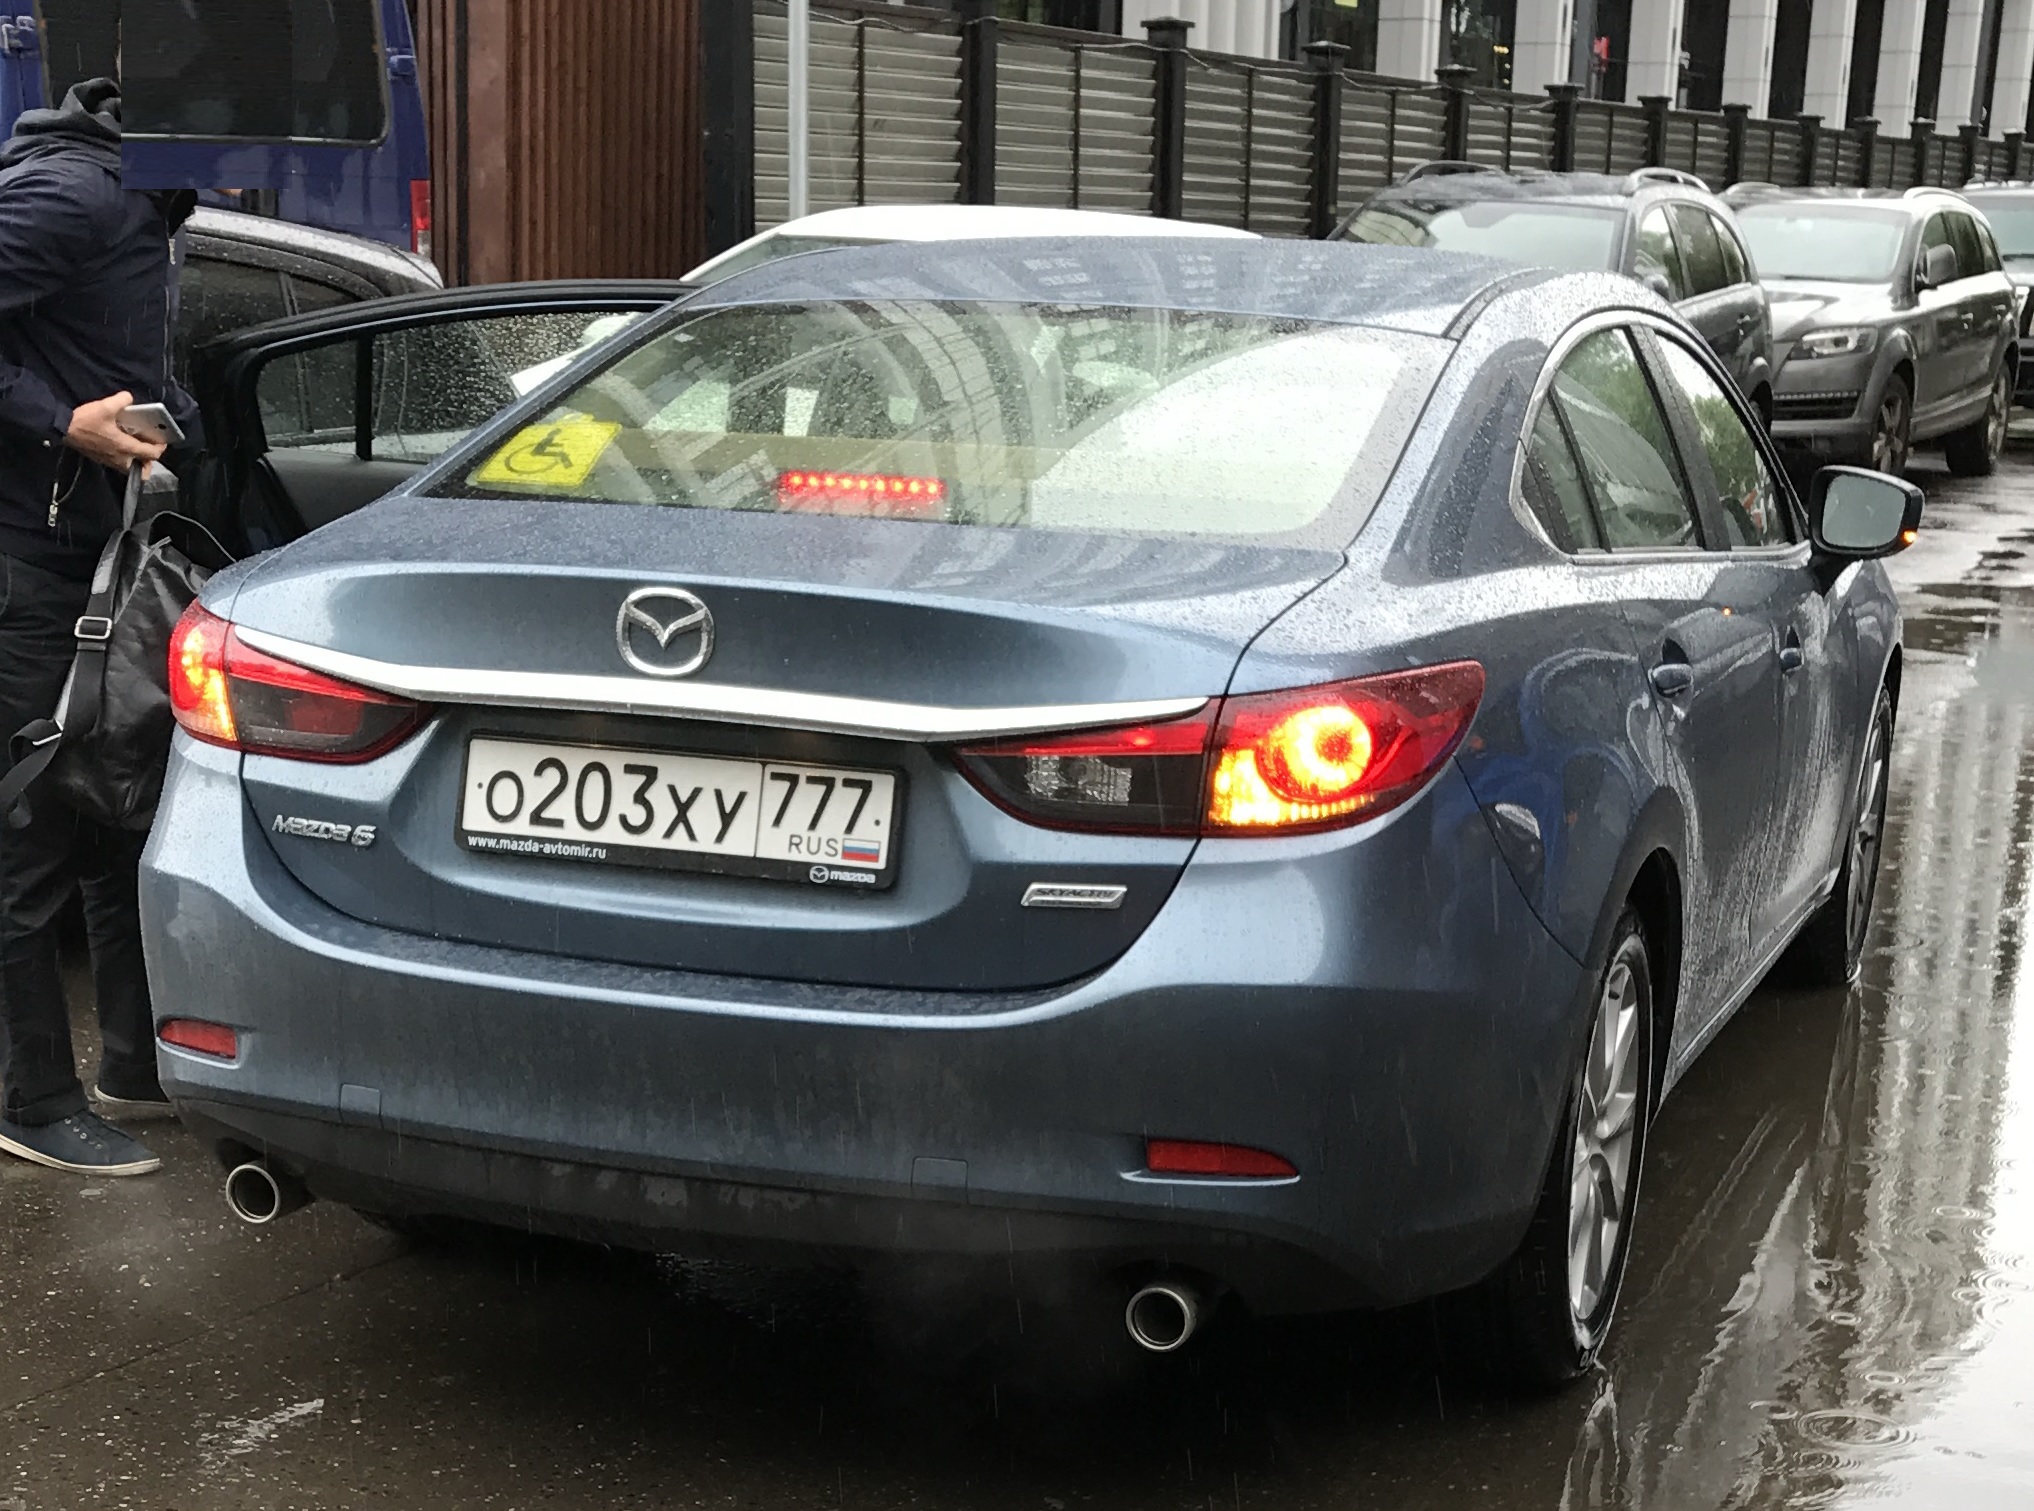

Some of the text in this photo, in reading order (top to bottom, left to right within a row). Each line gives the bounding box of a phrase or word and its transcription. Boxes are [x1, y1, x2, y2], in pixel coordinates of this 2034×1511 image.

[769, 771, 873, 834] 777
[468, 835, 607, 859] www.mazda-avtomir.ru
[788, 834, 839, 857] RUS
